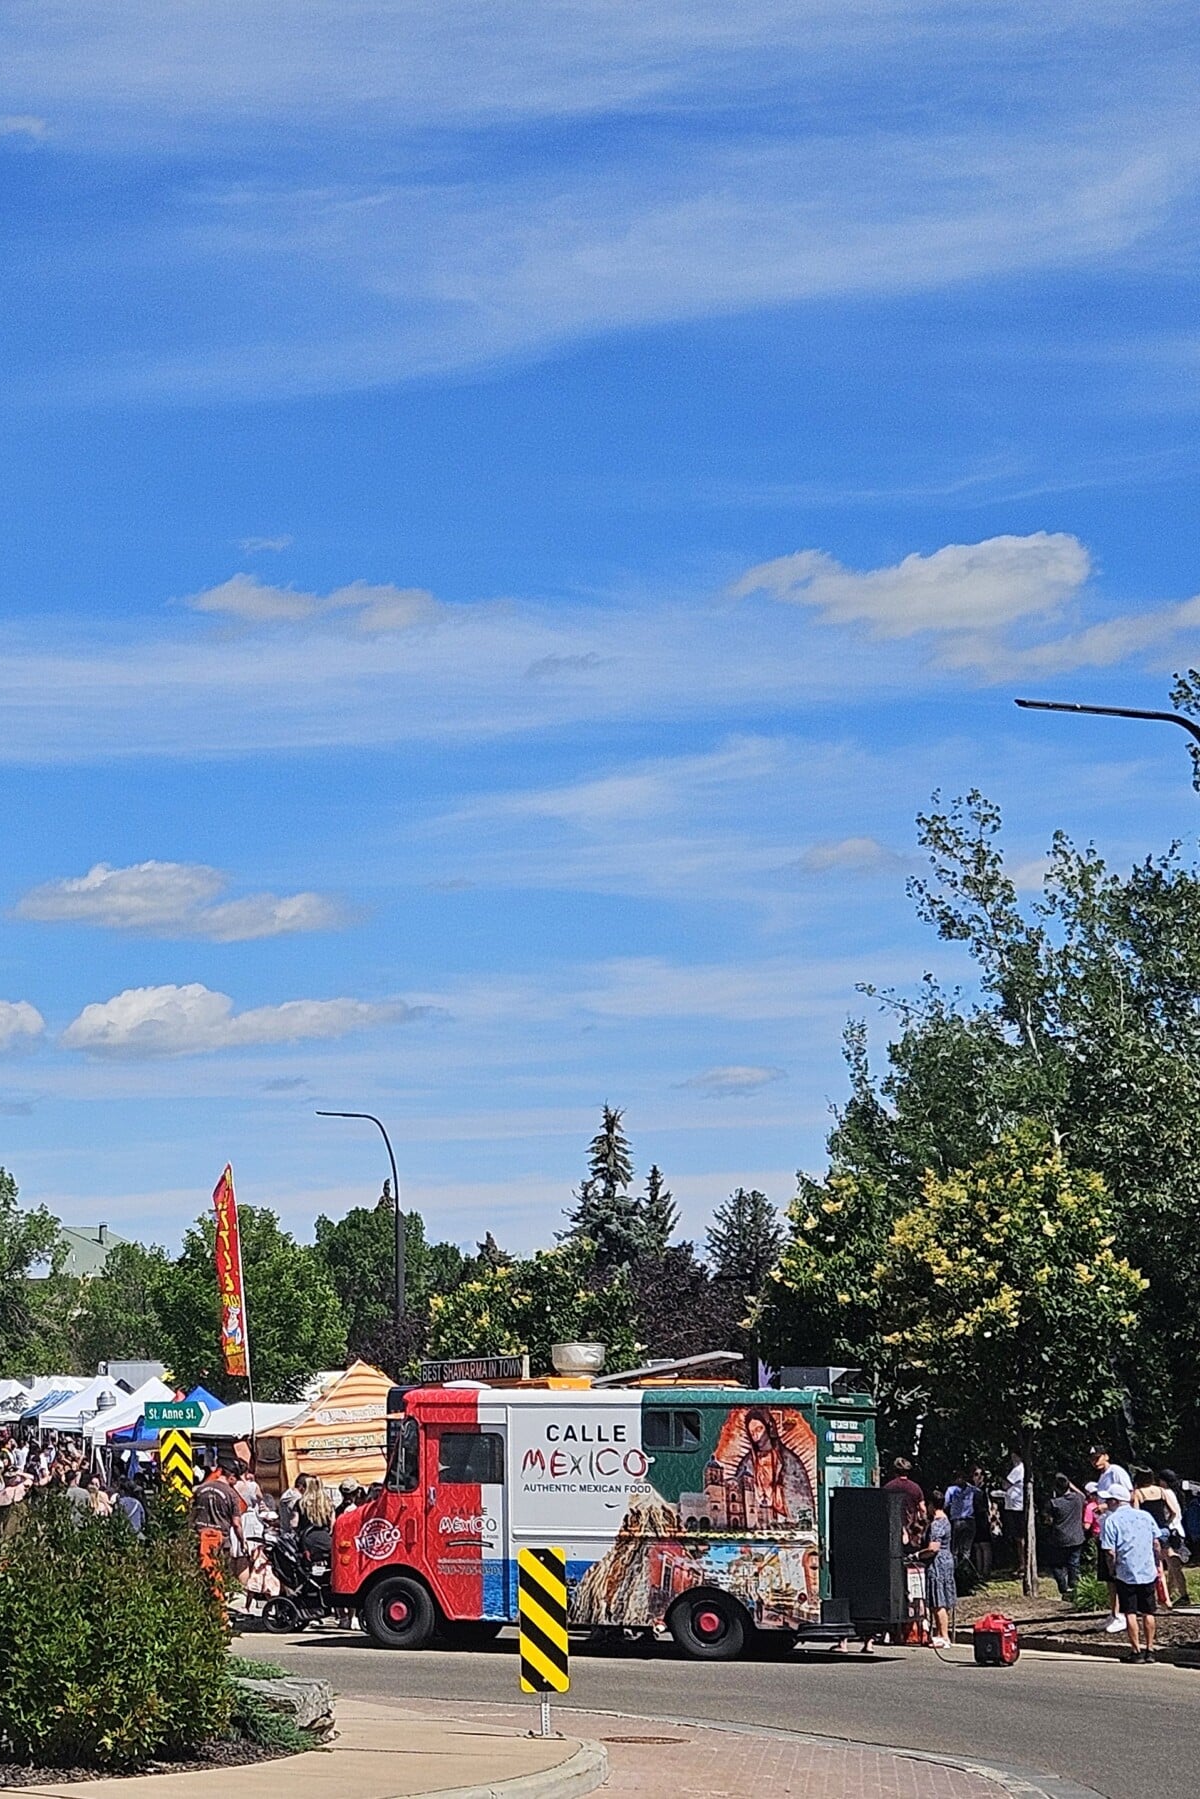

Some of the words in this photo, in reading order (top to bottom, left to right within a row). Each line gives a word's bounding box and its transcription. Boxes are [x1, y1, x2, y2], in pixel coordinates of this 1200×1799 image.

[422, 1365, 442, 1382] BEST
[443, 1361, 487, 1380] SHAWARMA
[488, 1360, 497, 1378] IN
[498, 1359, 522, 1377] TOWN
[148, 1408, 160, 1420] St.
[162, 1408, 184, 1420] Anne
[185, 1408, 197, 1420] St.
[545, 1424, 627, 1442] CALLE
[523, 1483, 577, 1493] AUTHENTIC
[579, 1484, 622, 1493] MEXICAN
[624, 1484, 652, 1494] FOOD
[354, 1528, 401, 1552] MEXICO
